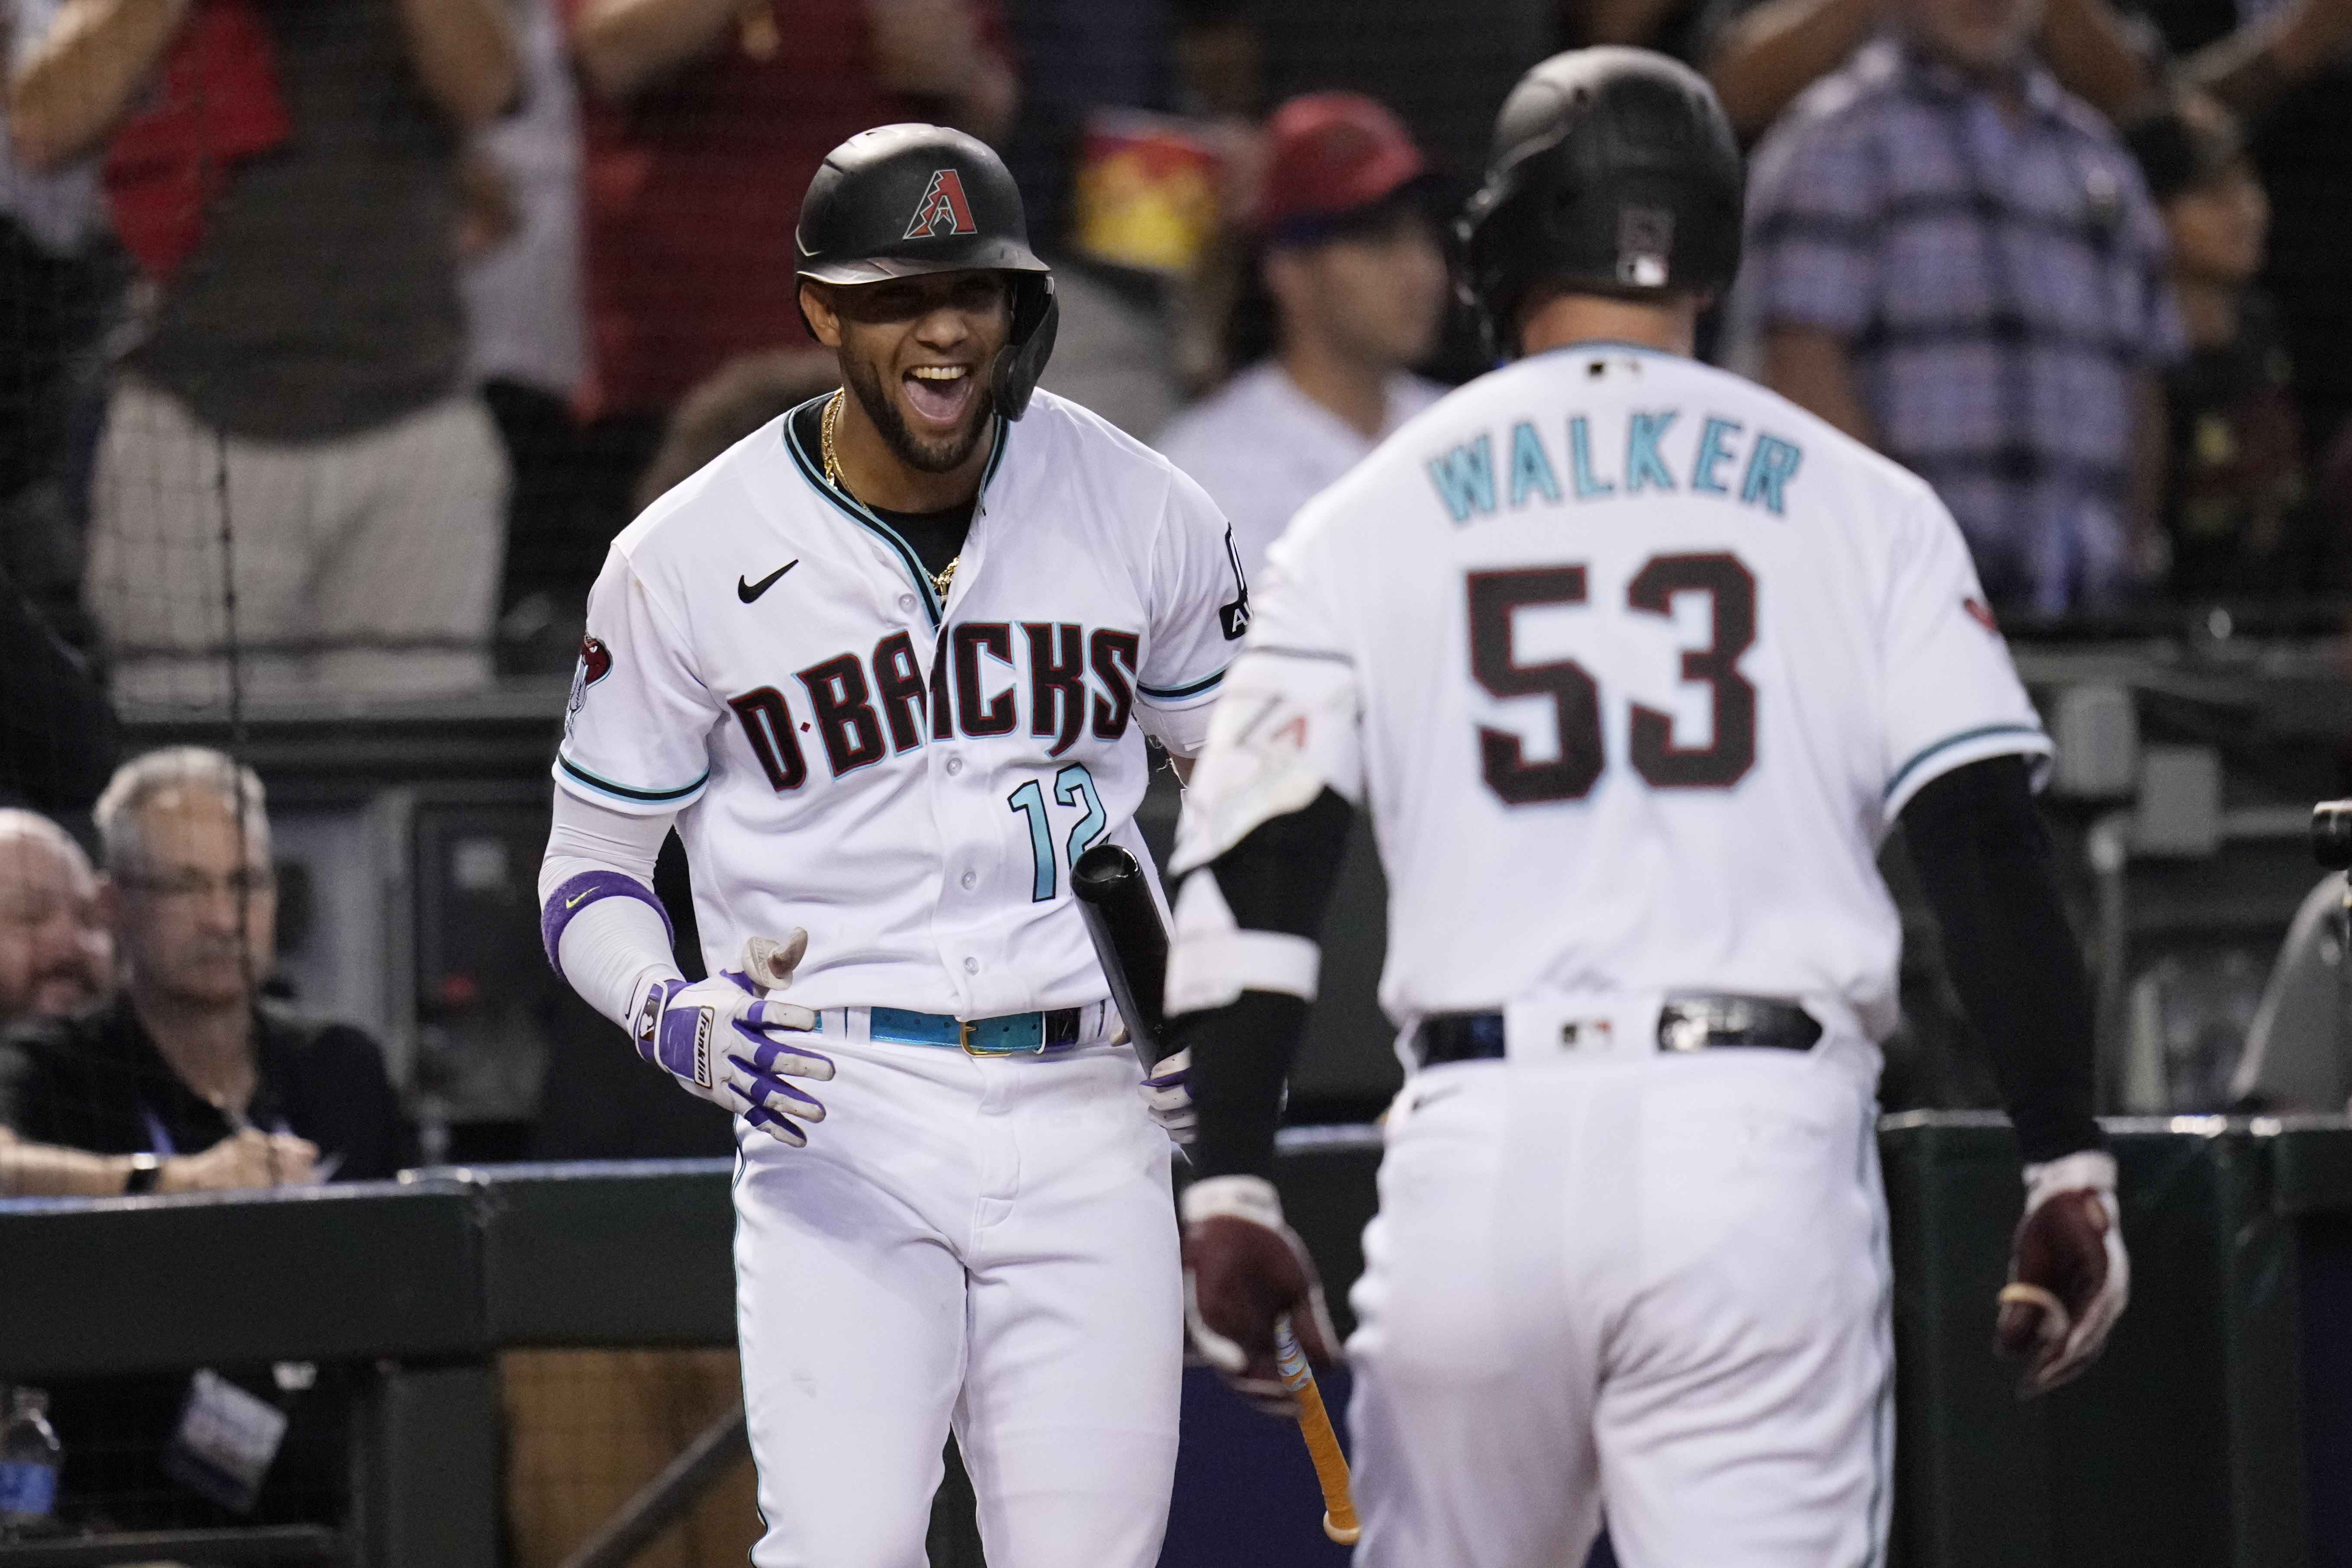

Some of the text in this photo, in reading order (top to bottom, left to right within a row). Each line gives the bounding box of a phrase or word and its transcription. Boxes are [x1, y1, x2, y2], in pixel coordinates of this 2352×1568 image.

[903, 169, 977, 239] A
[1426, 409, 1803, 523] WALKER
[1466, 550, 1757, 808] 53
[1008, 762, 1111, 903] 12
[698, 1011, 710, 1083] Franklin
